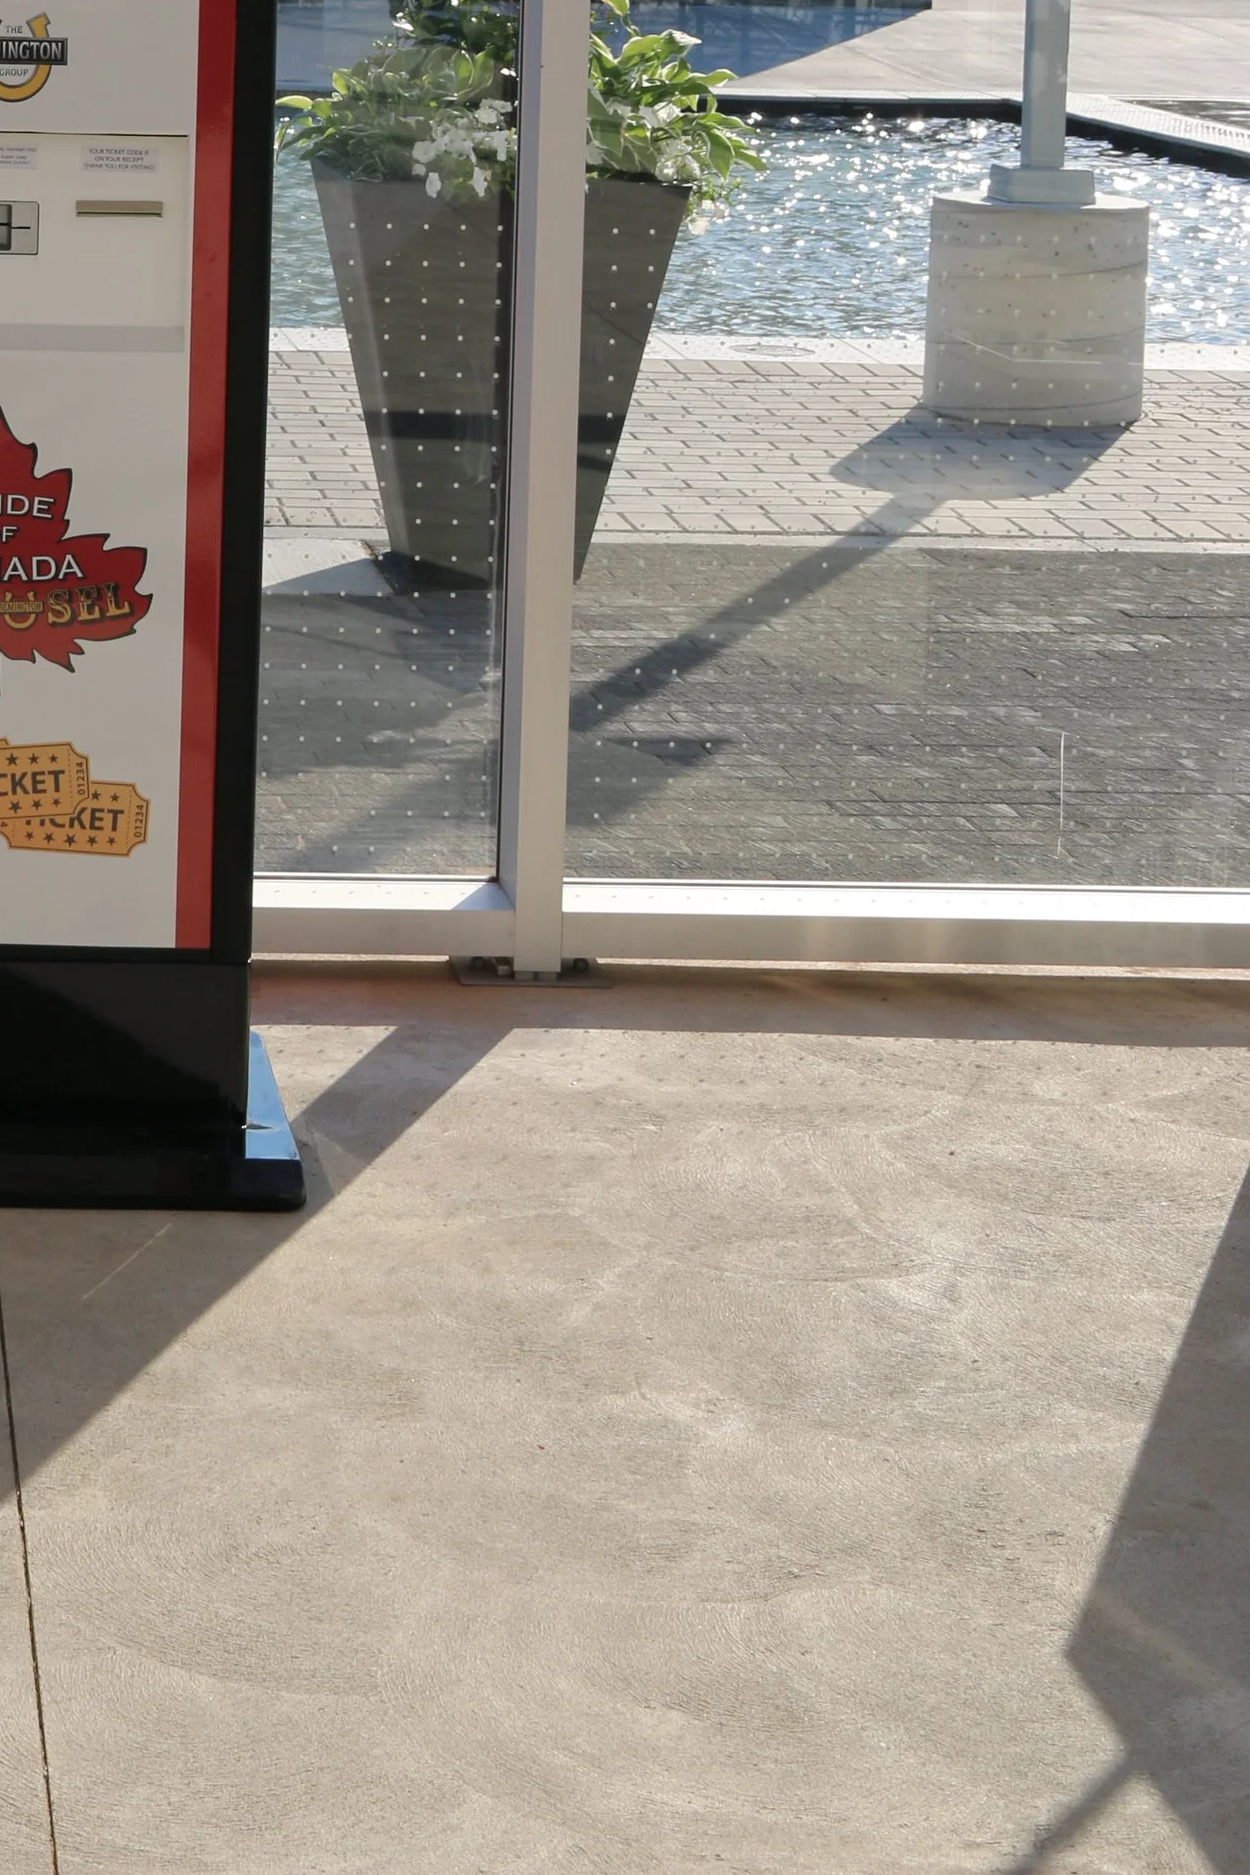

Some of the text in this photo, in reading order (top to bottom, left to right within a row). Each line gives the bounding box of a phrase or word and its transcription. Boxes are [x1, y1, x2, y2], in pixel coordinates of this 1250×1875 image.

[5, 25, 23, 34] THE
[77, 761, 86, 796] 01234
[134, 804, 144, 838] 01234
